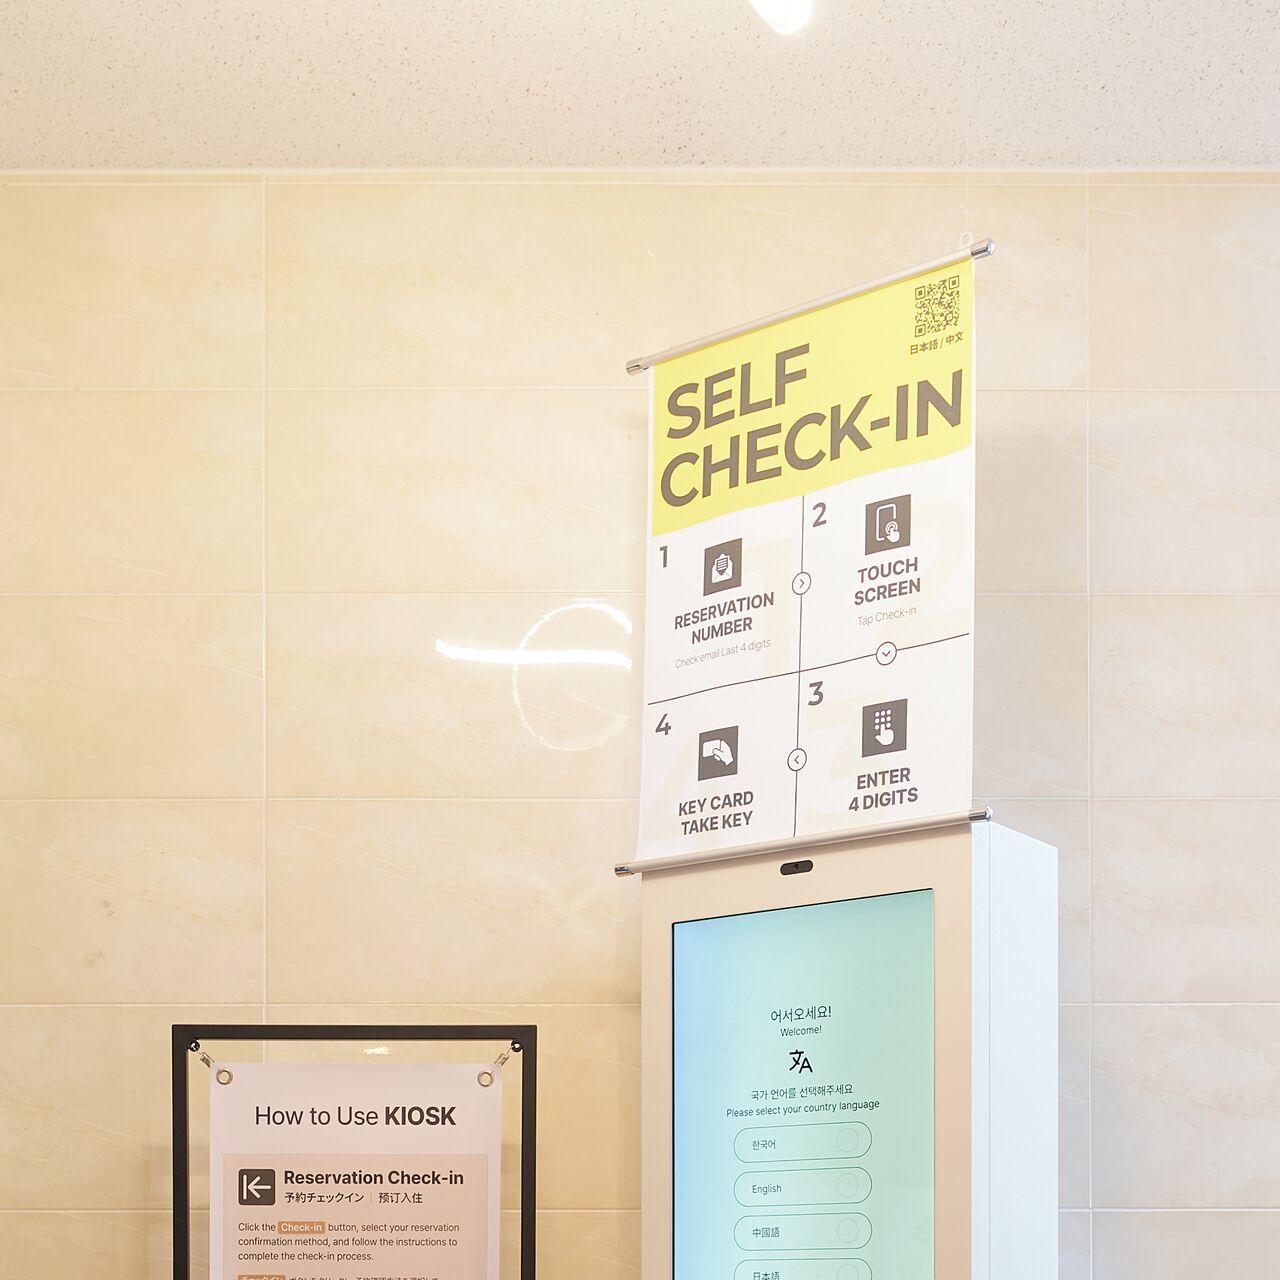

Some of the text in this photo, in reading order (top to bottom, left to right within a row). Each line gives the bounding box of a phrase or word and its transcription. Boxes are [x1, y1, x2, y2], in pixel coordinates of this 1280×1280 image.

[910, 331, 964, 355] 日本語 中文
[666, 344, 810, 439] SELF
[660, 368, 962, 506] CHECK-IN
[812, 502, 827, 528] 2
[659, 545, 668, 568] 1
[857, 556, 918, 583] TOUCH
[854, 577, 920, 606] SCREEN
[674, 592, 774, 629] RESERVATION
[857, 607, 916, 626] Tap Check-in
[691, 616, 752, 644] NUMBER
[675, 654, 699, 669] Check
[699, 649, 720, 662] email
[721, 646, 739, 657] Last
[747, 639, 771, 654] digits
[807, 680, 824, 706] 3
[655, 713, 672, 736] 4
[857, 767, 910, 790] ENTER
[678, 791, 754, 817] KEY CARD
[848, 786, 918, 812] 4 DIGITS
[681, 810, 753, 835] TAKE KEY
[780, 1025, 822, 1037] Welcome!
[255, 1106, 456, 1125] How to Use KIOSK
[726, 1100, 880, 1117] Please select your country language
[284, 1169, 464, 1185] Reservation Check-in
[378, 1192, 423, 1204] 预订入住
[751, 1183, 782, 1195] English
[238, 1222, 460, 1233] Click the Check-in button, select your reservation
[237, 1236, 458, 1248] confirmation method, and follow the instructions to
[237, 1251, 374, 1262] complete the check-in process.
